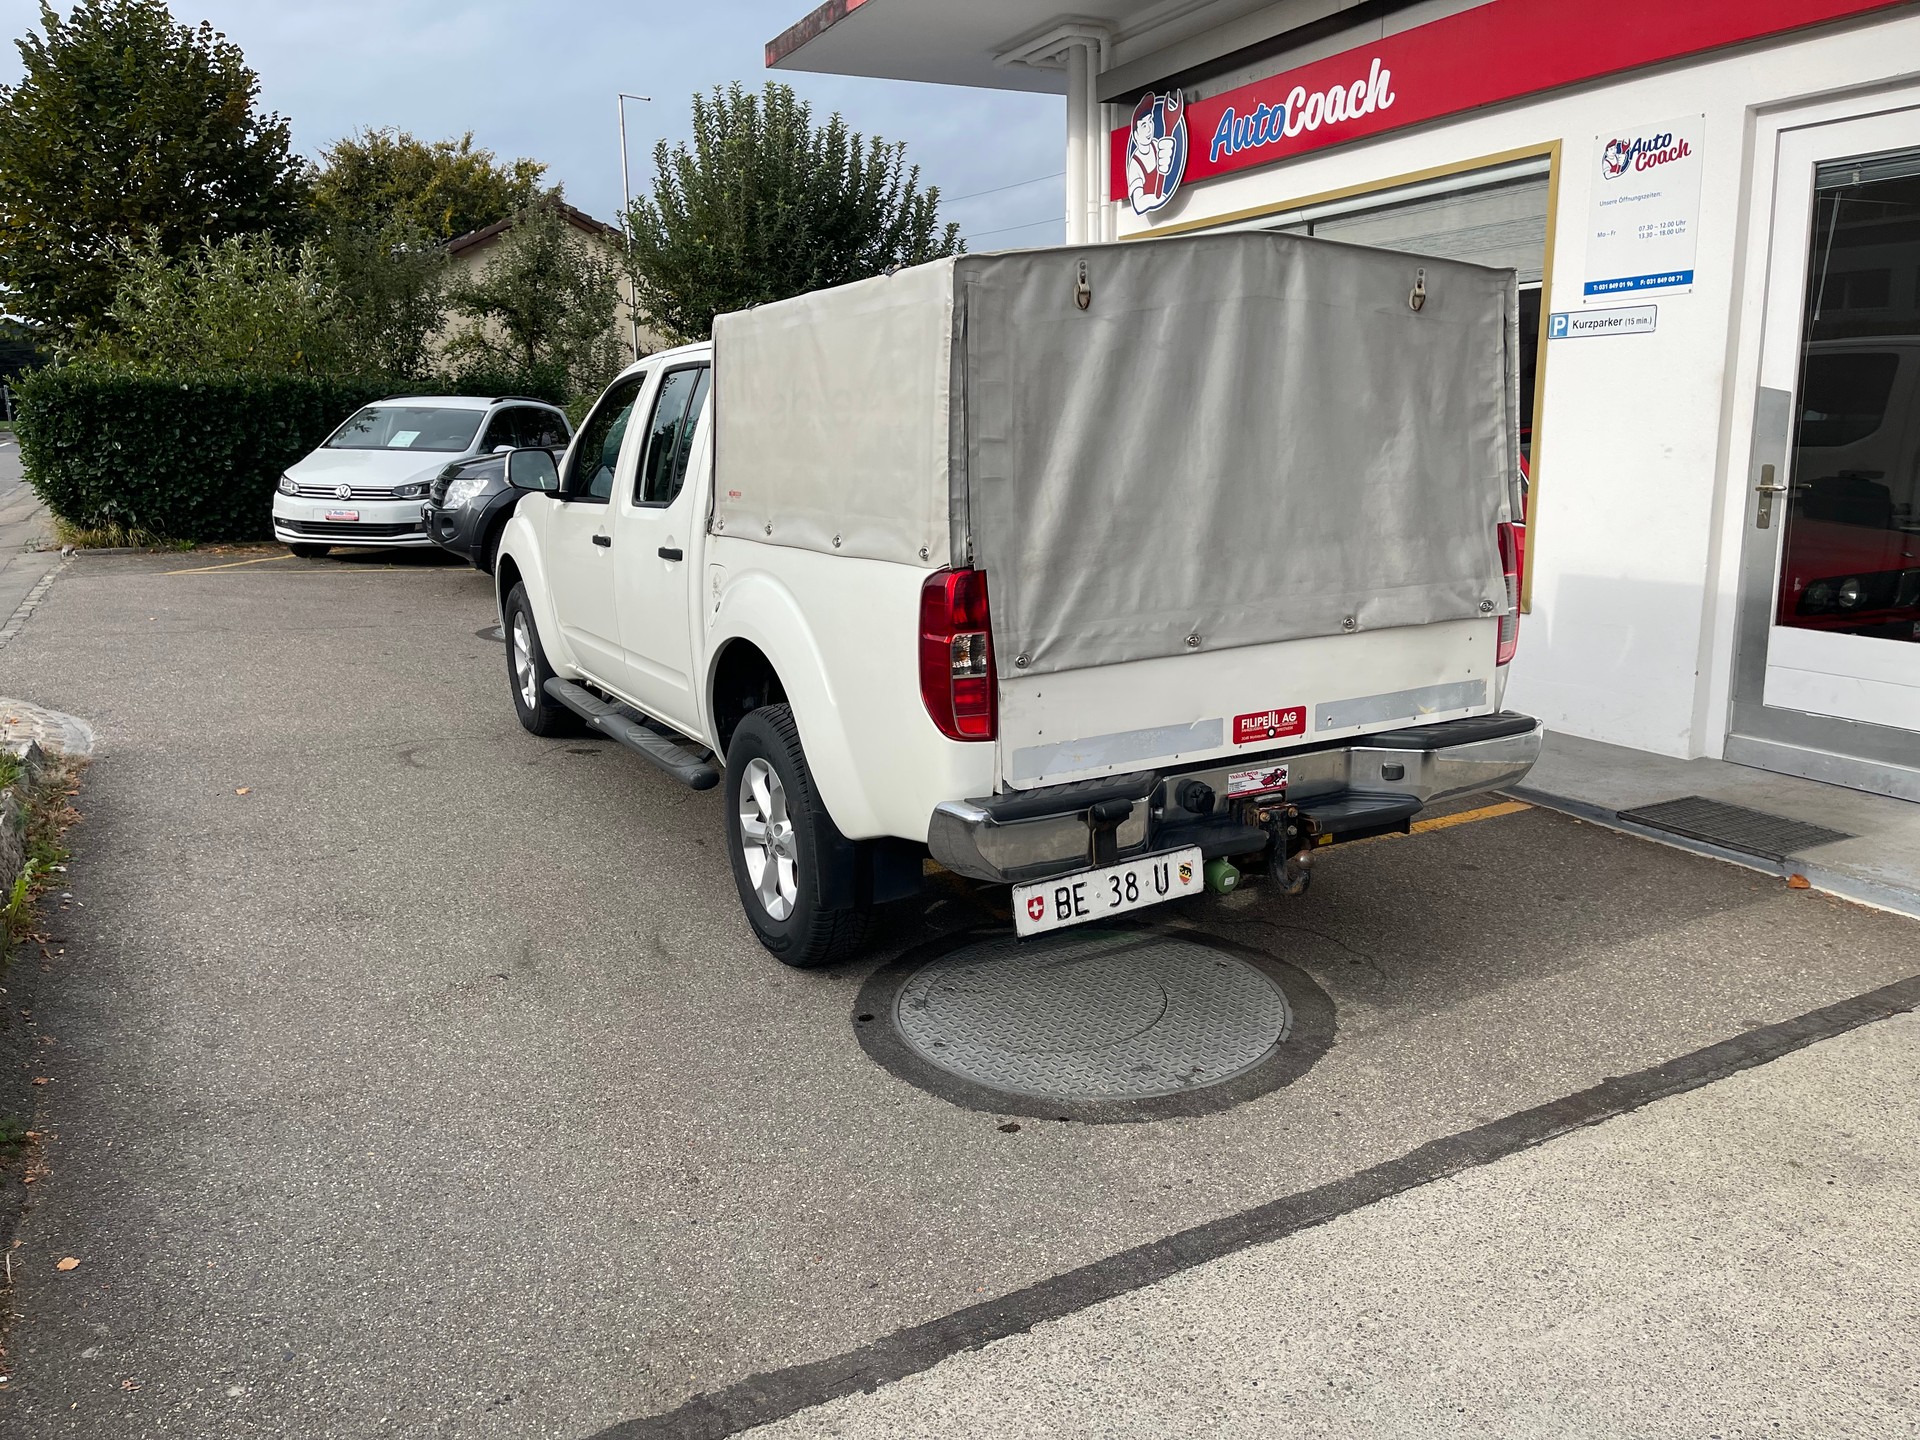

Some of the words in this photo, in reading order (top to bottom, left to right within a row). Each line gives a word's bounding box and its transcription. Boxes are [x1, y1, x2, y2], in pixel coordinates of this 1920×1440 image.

[1209, 57, 1396, 163] AutoCoach
[1629, 132, 1672, 160] Auto
[1635, 138, 1692, 172] Coach
[1599, 199, 1618, 207] Unsere
[1638, 224, 1653, 232] 07.30
[1659, 221, 1675, 229] 12.00
[1638, 231, 1653, 239] 13.30
[1553, 316, 1567, 336] P
[1572, 317, 1624, 330] Kurzparker
[1625, 318, 1635, 327] (15
[1636, 316, 1653, 325] min.)
[1282, 712, 1297, 723] AG
[1054, 881, 1090, 921] BE
[1108, 871, 1140, 908] 38
[1154, 863, 1170, 896] U
